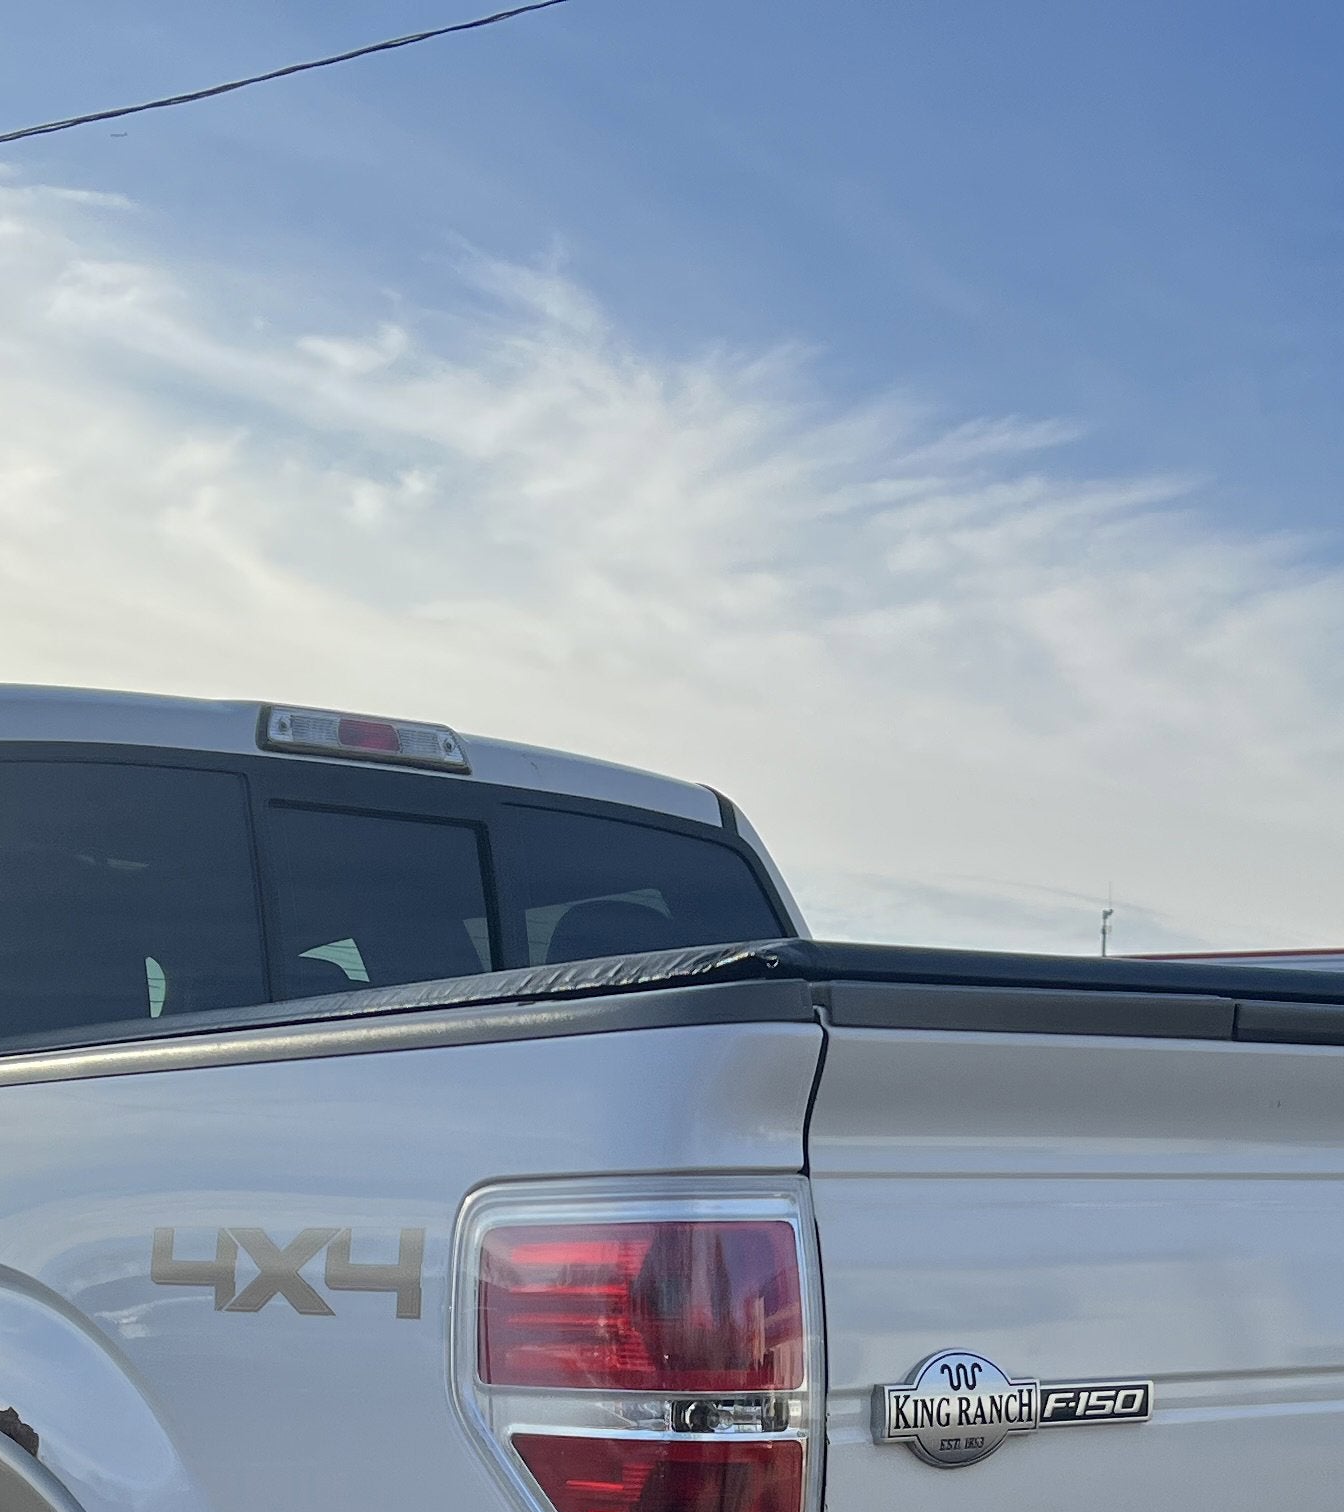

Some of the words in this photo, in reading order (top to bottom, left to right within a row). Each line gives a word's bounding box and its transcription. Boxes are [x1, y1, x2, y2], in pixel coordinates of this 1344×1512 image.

[893, 1394, 951, 1430] KING
[957, 1388, 1034, 1427] RANCH
[1044, 1388, 1145, 1419] F-150
